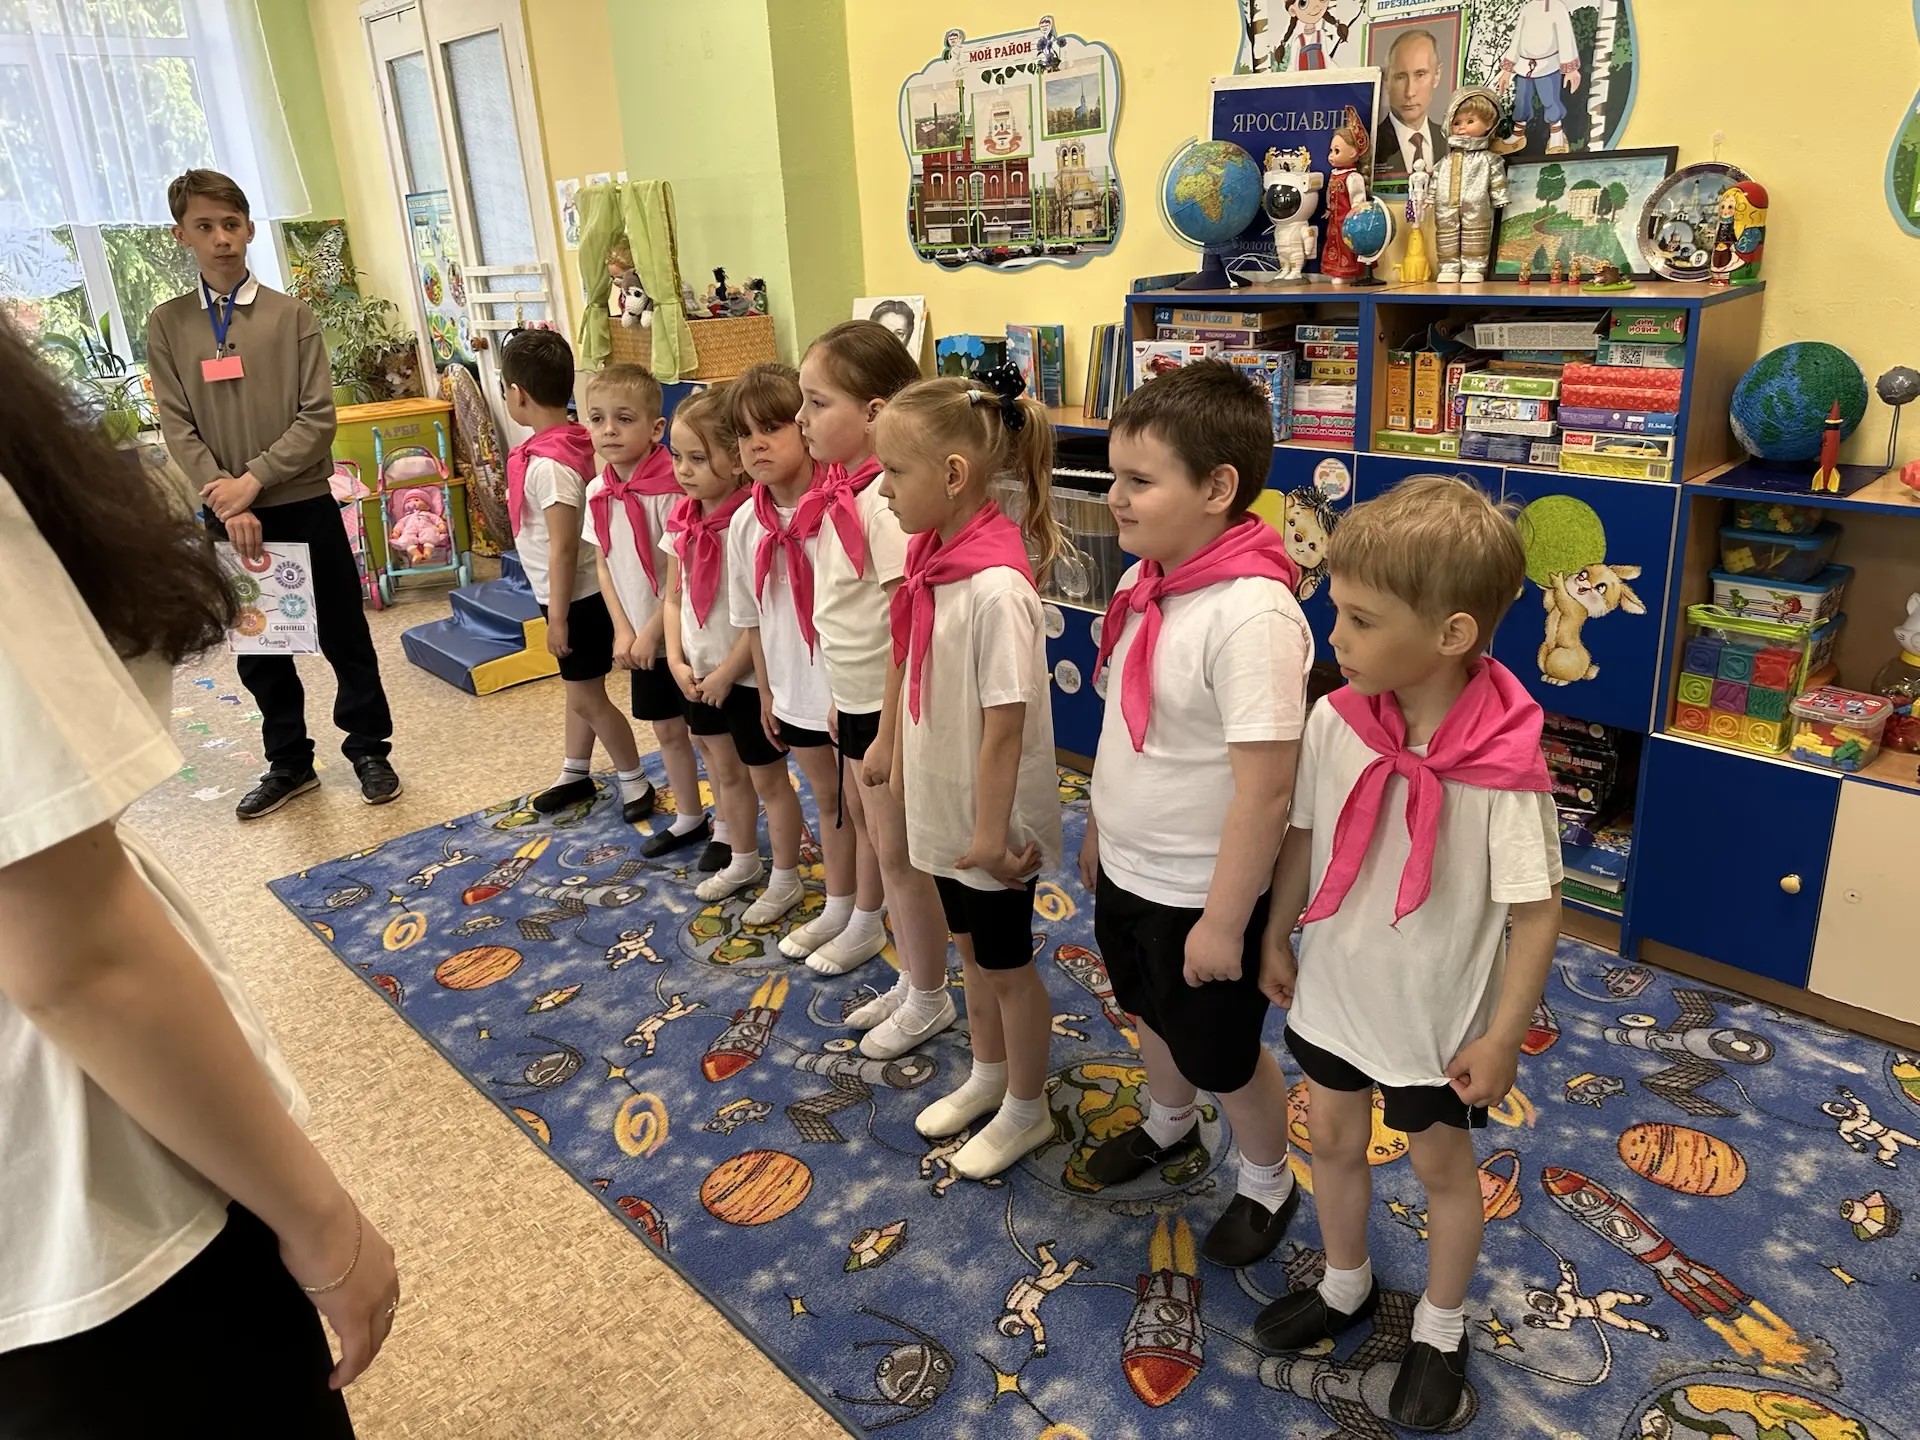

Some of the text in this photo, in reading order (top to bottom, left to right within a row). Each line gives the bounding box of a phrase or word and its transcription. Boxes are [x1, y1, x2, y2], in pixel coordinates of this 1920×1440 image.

[1377, 0, 1436, 10] ПРЕЗИДЕ
[969, 41, 1032, 63] МОЙ РАЙОН
[1238, 240, 1275, 251] ЗОЛОТО
[1159, 310, 1233, 324] 42 MAXI PUZZLE
[1635, 318, 1655, 327] МИР
[1162, 329, 1170, 338] 15
[1225, 332, 1237, 340] ДОМ
[1628, 325, 1661, 335] ЖИВОЙ
[1314, 346, 1323, 355] 35
[1233, 357, 1259, 365] ПАЗЛЫ
[1470, 378, 1479, 387] 15
[1551, 752, 1572, 765] БЛОКИ
[1572, 756, 1603, 771] ДЬЕНЕША
